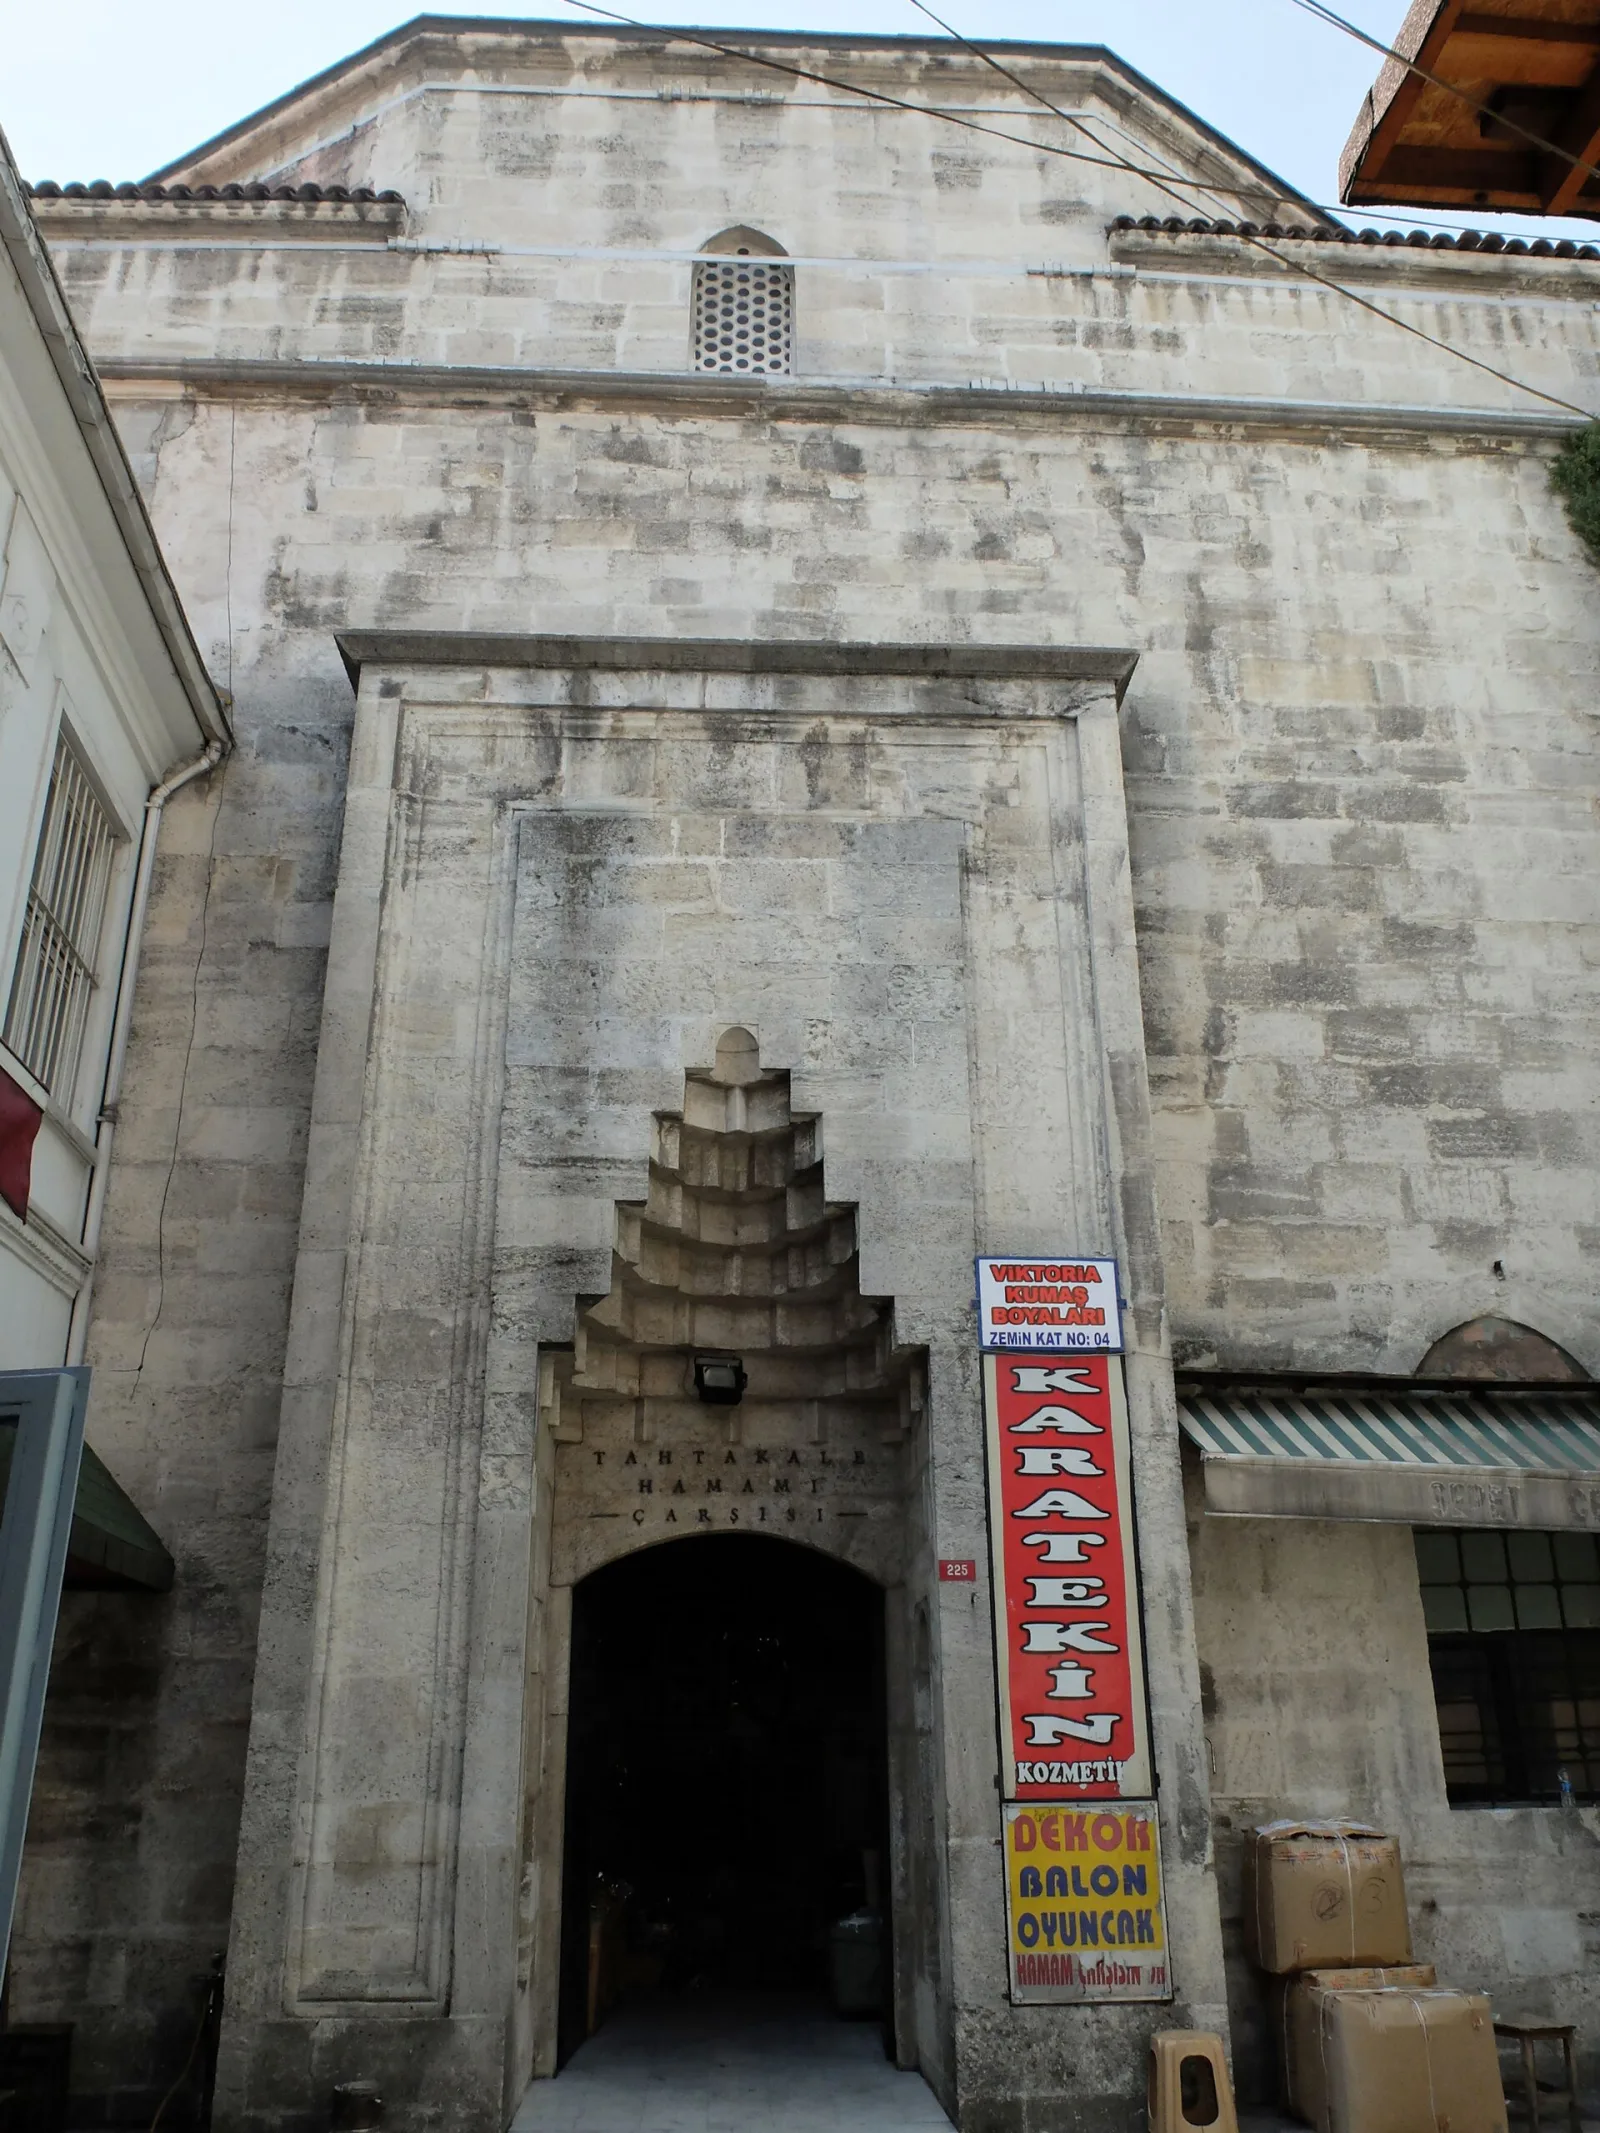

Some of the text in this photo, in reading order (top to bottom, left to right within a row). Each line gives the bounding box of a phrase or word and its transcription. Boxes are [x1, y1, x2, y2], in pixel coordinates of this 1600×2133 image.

[1004, 1286, 1089, 1307] KUMAŞ
[991, 1307, 1105, 1325] BOYALARI
[1036, 1332, 1062, 1345] KAT
[1066, 1332, 1090, 1345] NO:
[1094, 1332, 1110, 1345] 04
[592, 1451, 865, 1465] TAHTAKALE
[638, 1479, 818, 1494] HAMAMI
[632, 1507, 824, 1526] ÇARŞISI
[946, 1563, 968, 1576] 225
[1014, 1814, 1150, 1852] DEKOR
[1019, 1864, 1147, 1897] BALON
[1017, 1909, 1155, 1948] OYUNCAK
[1016, 1954, 1073, 1985] HAMAM
